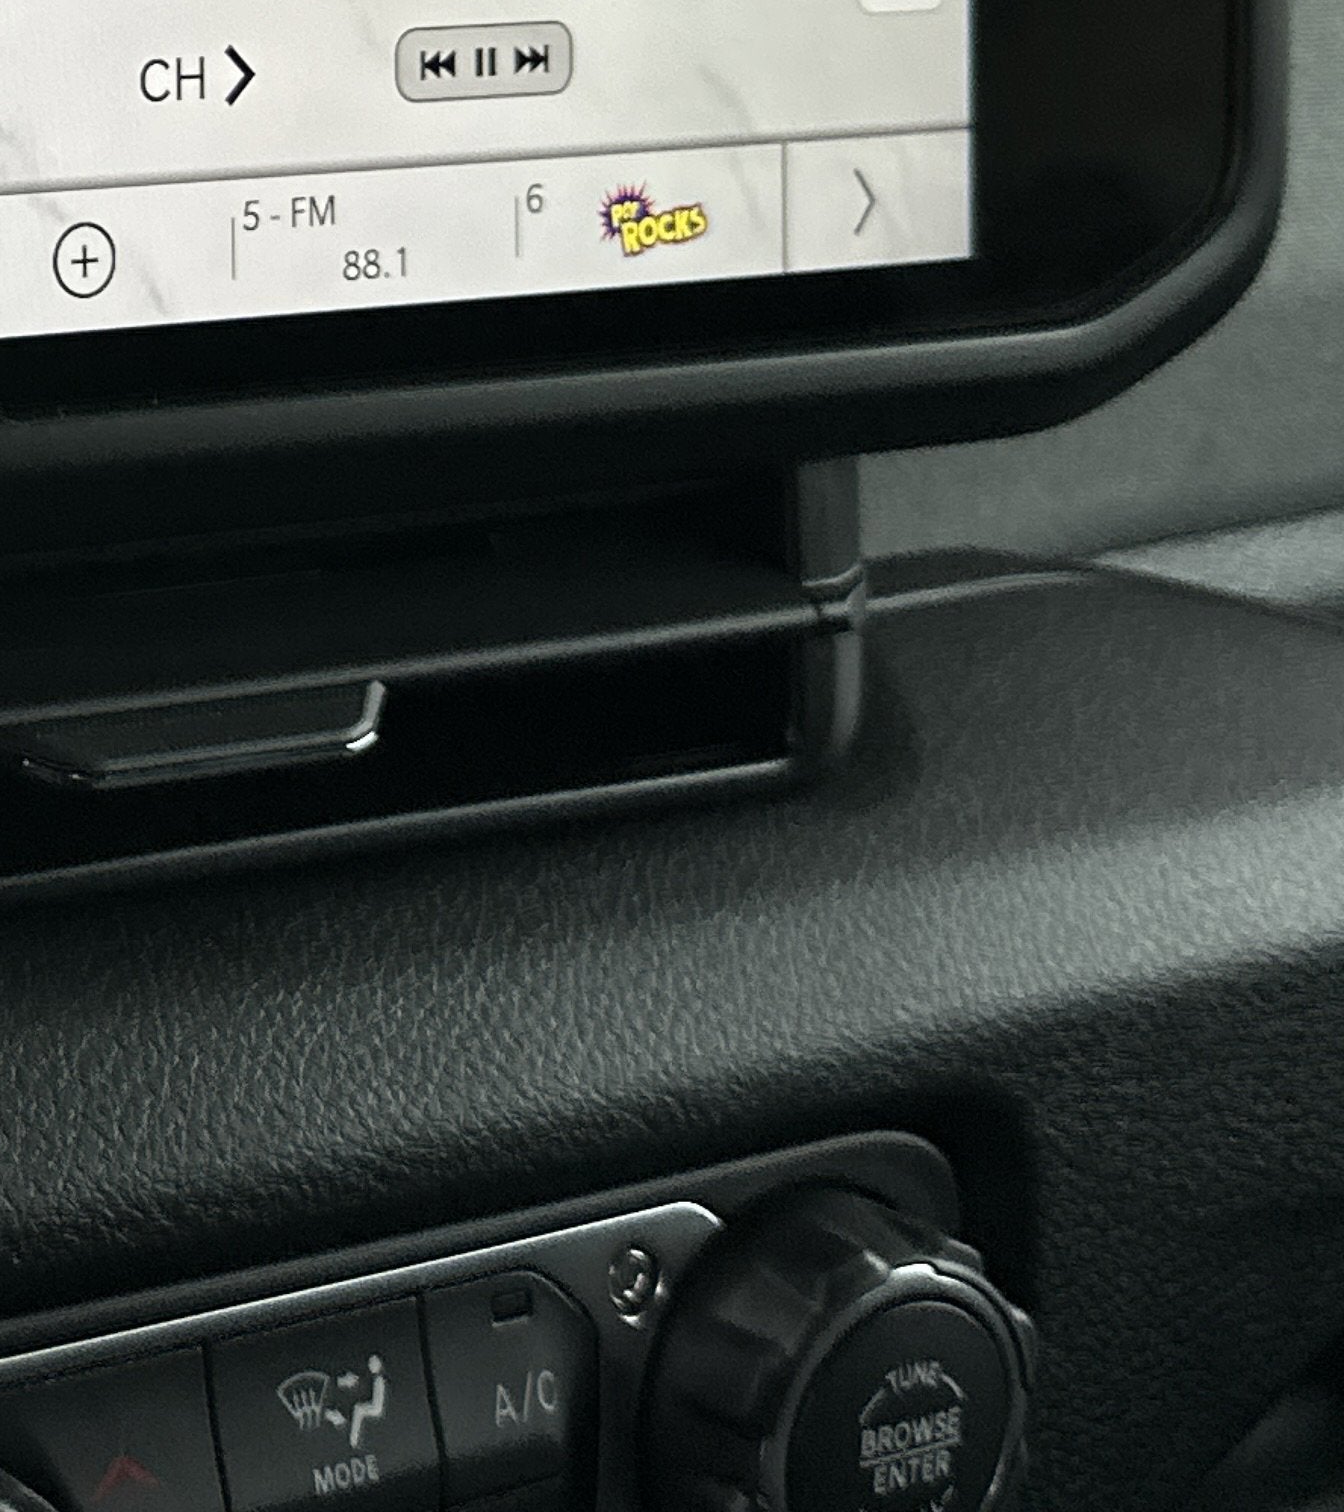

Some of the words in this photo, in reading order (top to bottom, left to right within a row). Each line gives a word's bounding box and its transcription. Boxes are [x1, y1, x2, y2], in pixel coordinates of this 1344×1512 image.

[140, 56, 205, 103] CH
[243, 199, 260, 231] 5
[291, 194, 336, 228] FM
[526, 183, 544, 214] 6
[621, 206, 706, 254] ROCKS
[342, 246, 408, 281] 88.1
[496, 1369, 557, 1427] A/C
[885, 1360, 940, 1395] TUNE
[861, 1406, 962, 1457] BROWSE
[313, 1454, 380, 1495] MODE
[874, 1450, 950, 1495] ENTER
